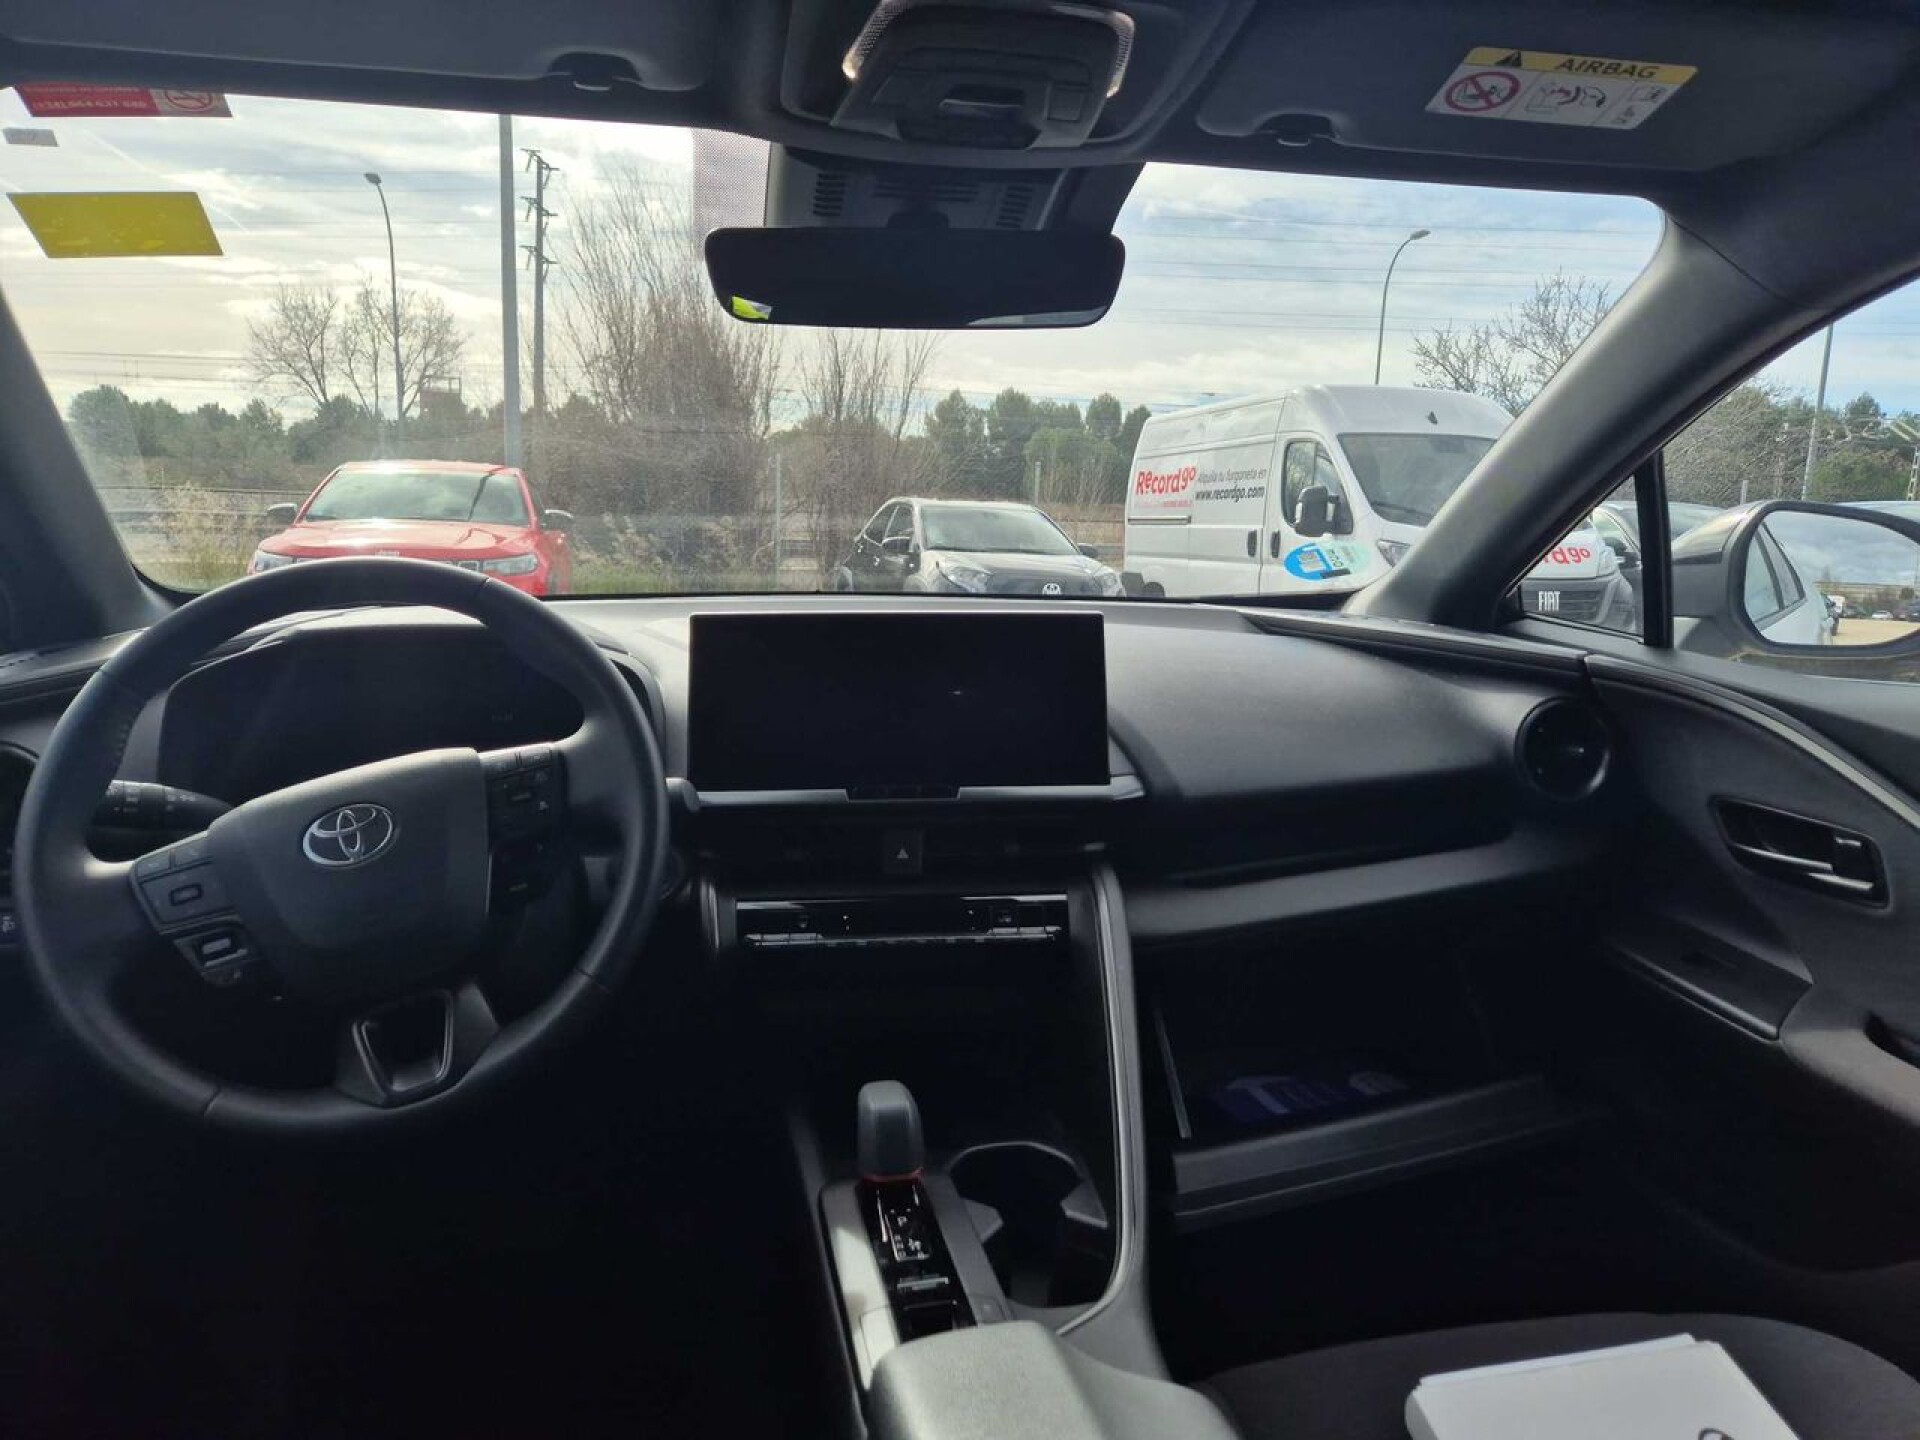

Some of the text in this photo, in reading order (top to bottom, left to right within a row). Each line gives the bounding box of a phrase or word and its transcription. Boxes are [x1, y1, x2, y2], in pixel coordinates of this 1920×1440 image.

[1555, 58, 1659, 79] AIRBAG
[1196, 485, 1265, 502] www.recordgo.com
[1538, 591, 1561, 612] FIAT
